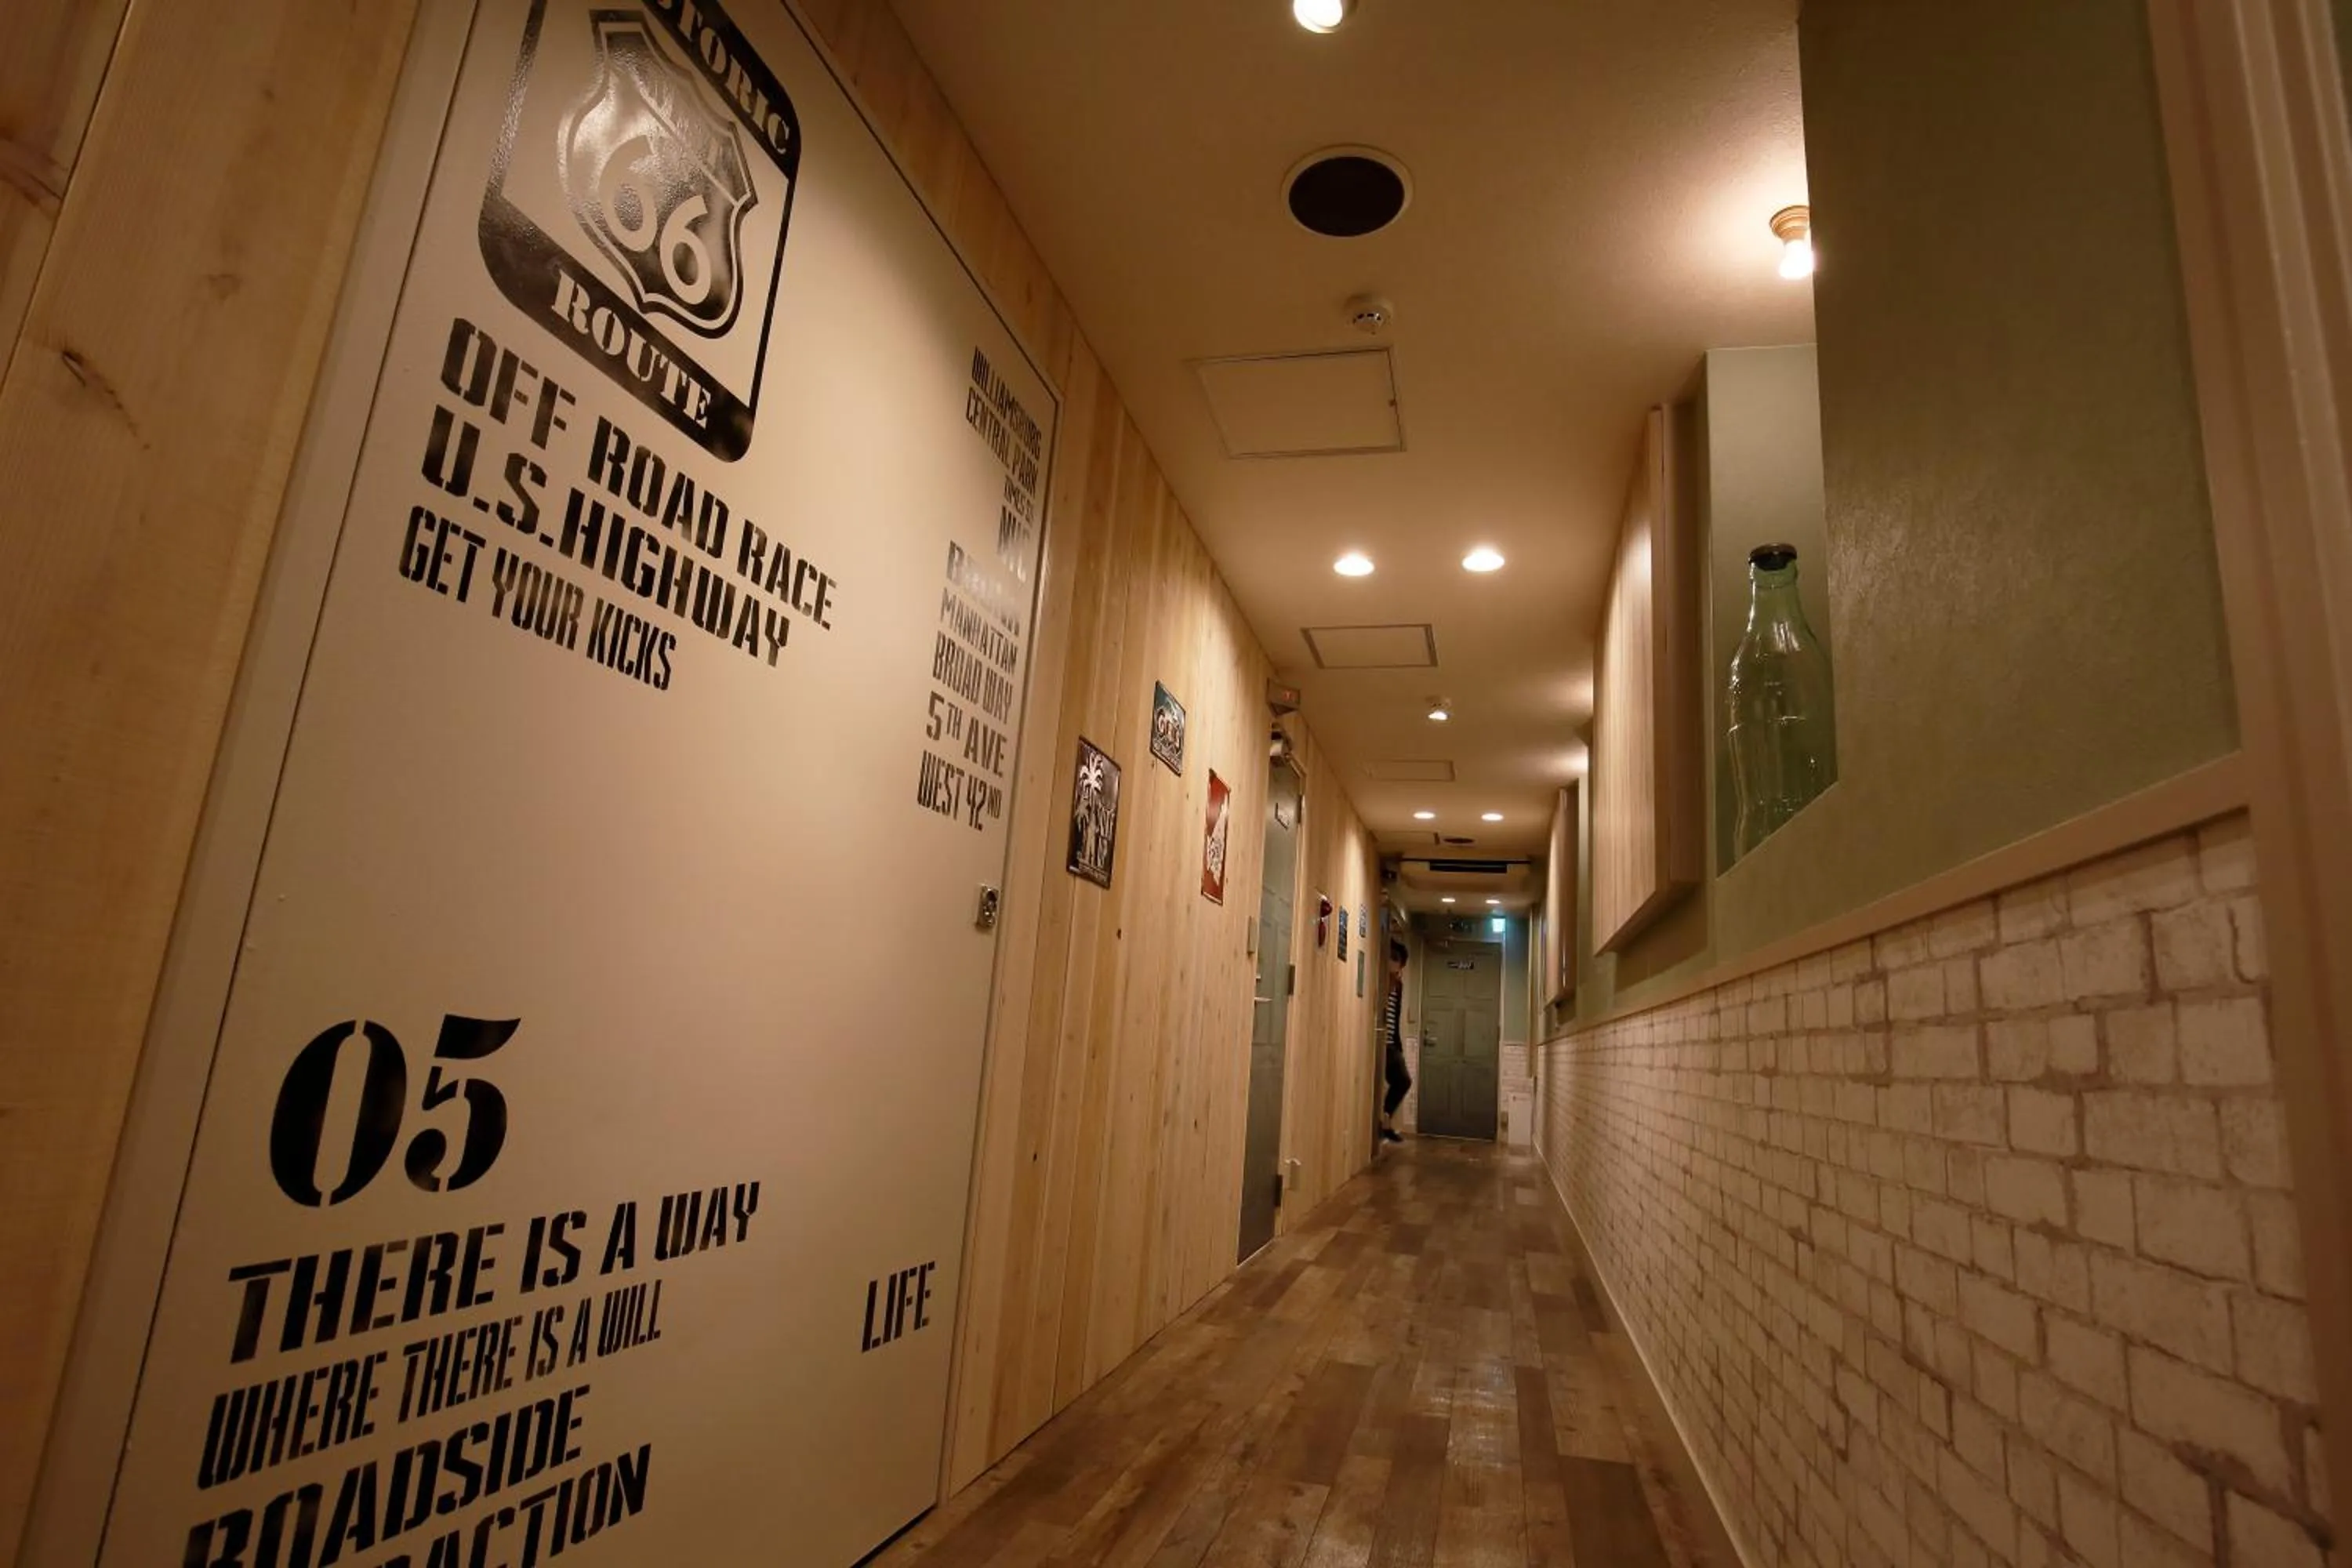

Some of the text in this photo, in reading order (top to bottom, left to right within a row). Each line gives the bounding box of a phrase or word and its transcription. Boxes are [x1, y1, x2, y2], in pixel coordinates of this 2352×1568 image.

[655, 0, 790, 154] TORIC
[598, 134, 712, 305] 66
[550, 268, 713, 430] ROUTE
[441, 318, 576, 450] OFF
[587, 416, 731, 562] ROAD
[738, 518, 838, 631] RACE
[965, 387, 1010, 470] CENTRAL
[1011, 445, 1039, 499] PARK
[398, 505, 677, 691] GET YOUR KICKS
[940, 586, 1018, 677] MANHATTAN
[932, 630, 1014, 726] BROAD WAY
[963, 718, 1007, 779] AVE
[916, 749, 965, 822] WEST
[269, 1013, 521, 1208] 05
[227, 1181, 760, 1365] THERE IS A WAY
[861, 1261, 935, 1352] LIFE
[197, 1279, 662, 1490] WHERE THERE IS A WILL
[183, 1385, 590, 1568] ROADSIDE
[375, 1443, 652, 1568] CTION
